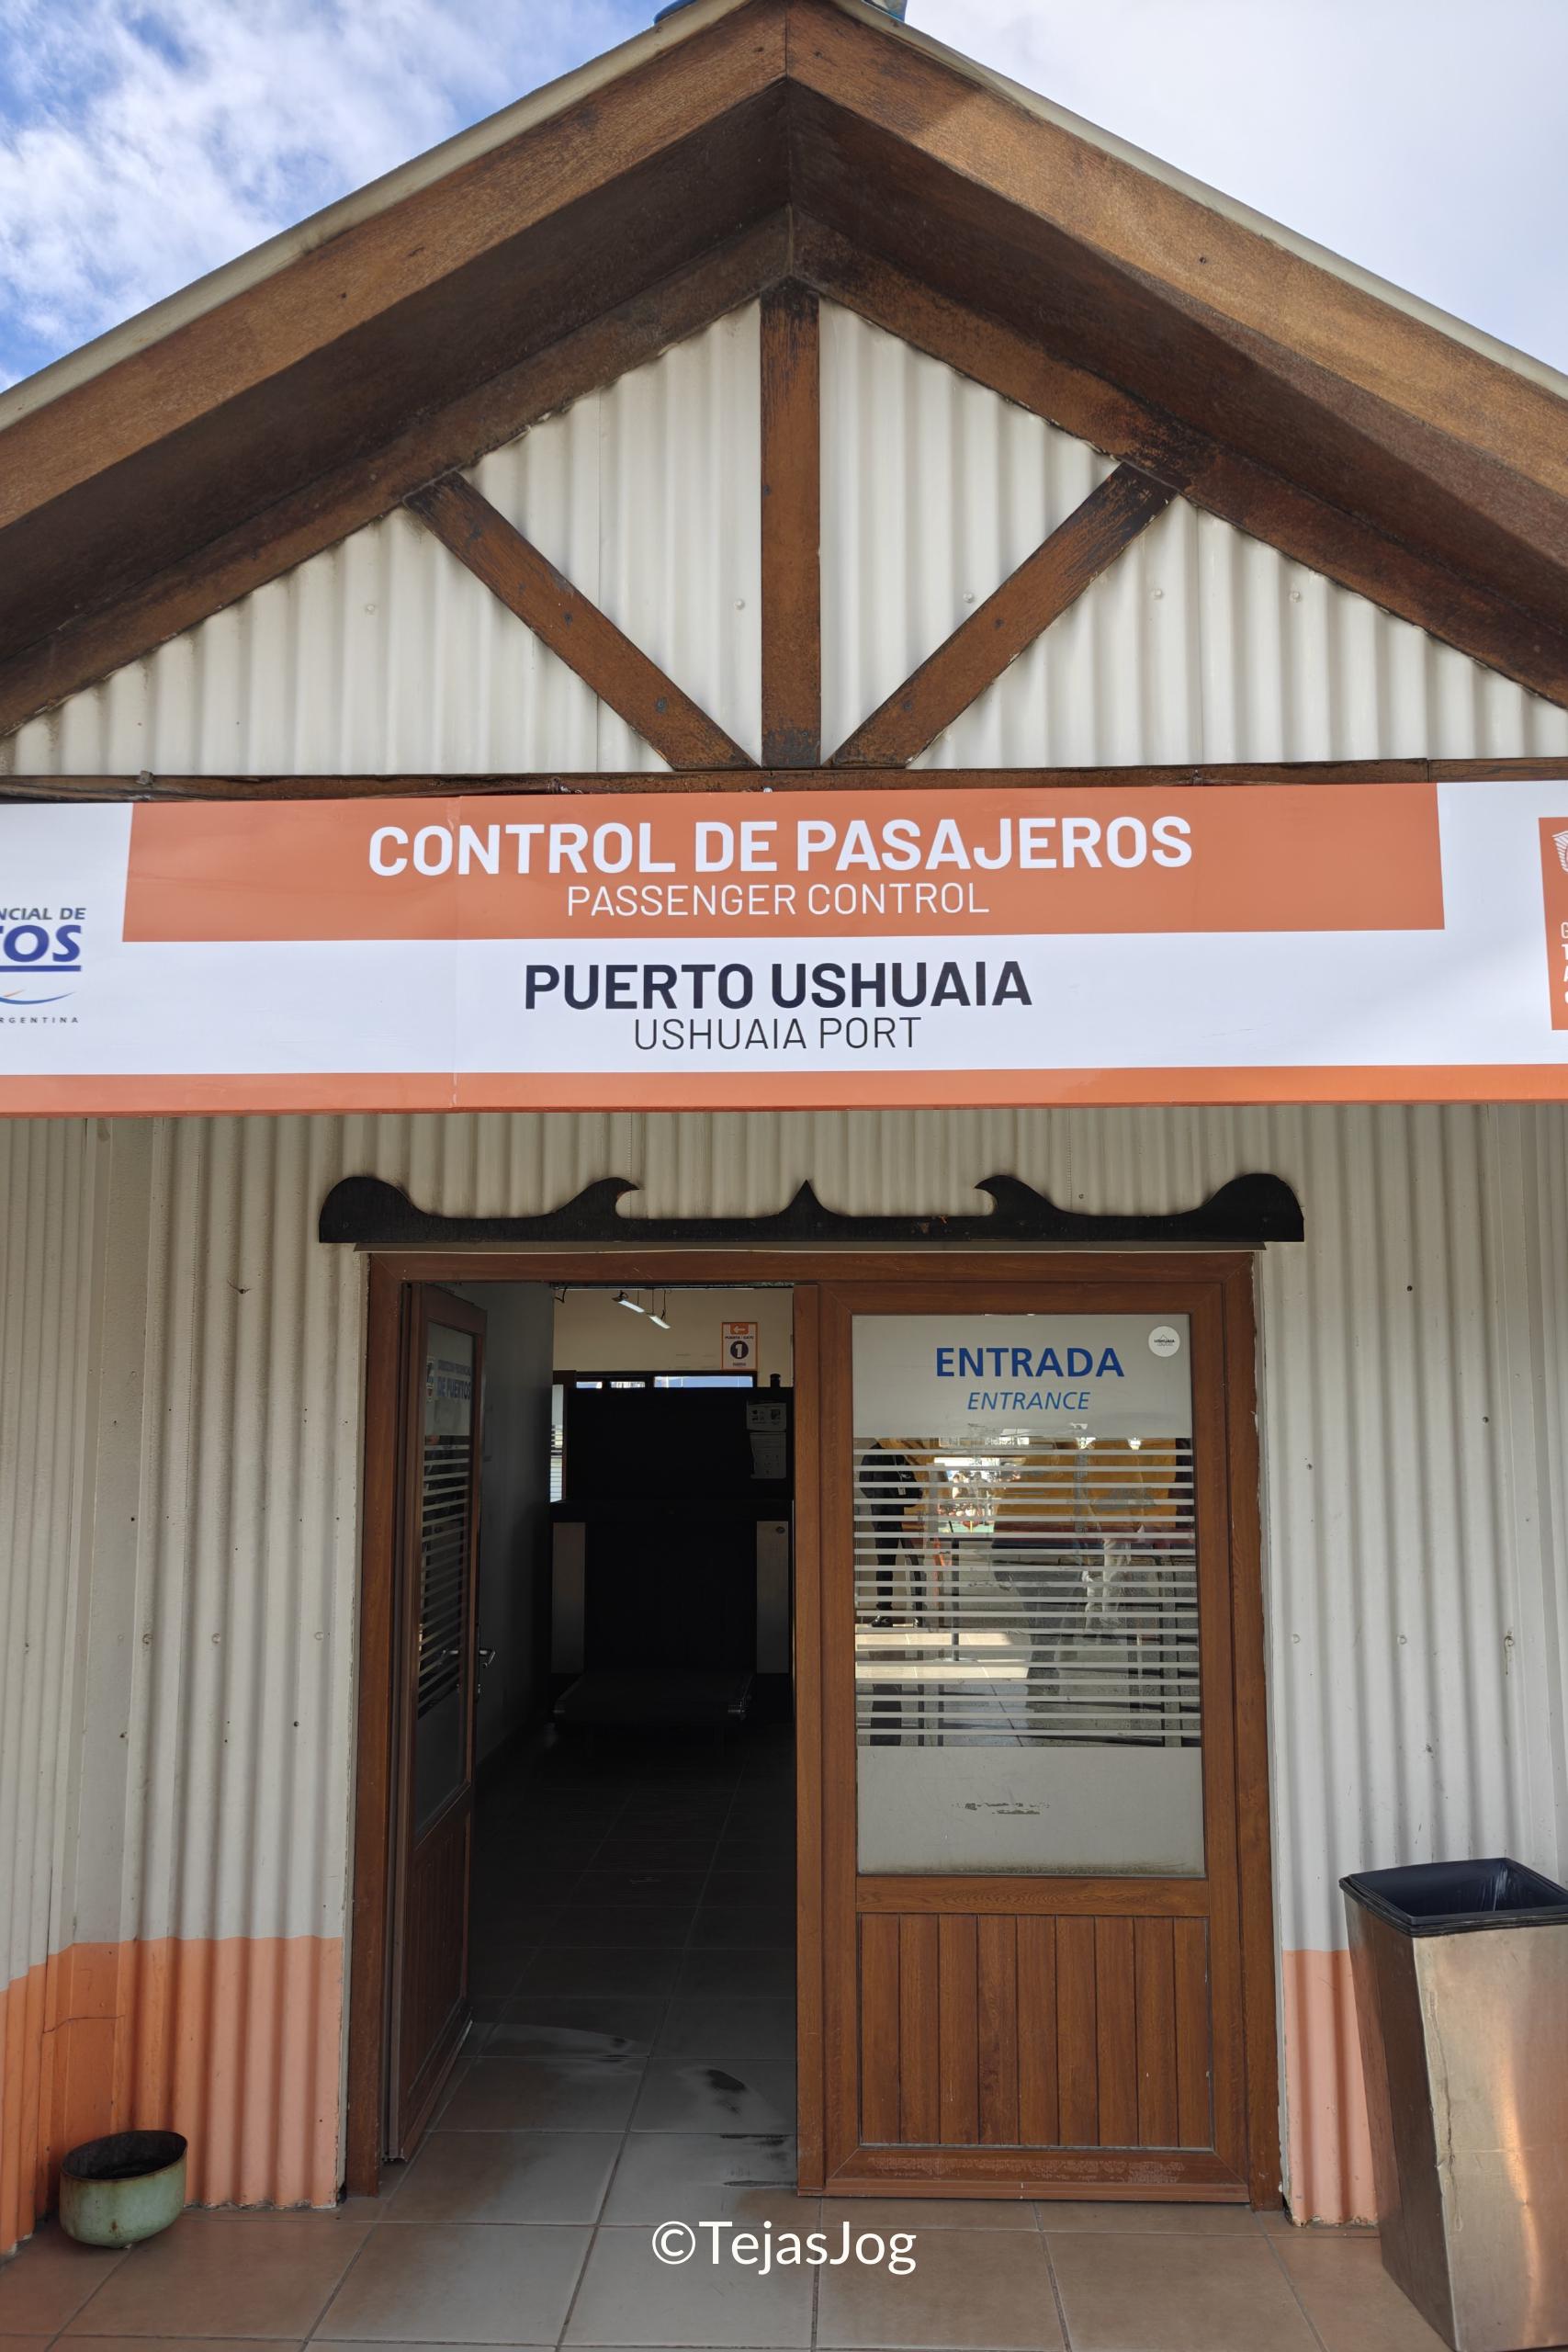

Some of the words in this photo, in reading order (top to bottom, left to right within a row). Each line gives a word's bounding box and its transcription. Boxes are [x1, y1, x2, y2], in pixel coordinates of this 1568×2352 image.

[369, 822, 676, 876] CONTROL
[695, 820, 777, 873] DE
[797, 816, 1192, 871] PASAJEROS
[60, 908, 86, 920] DE
[568, 884, 795, 916] PASSENGER
[808, 882, 989, 915] CONTROL
[0, 924, 82, 963] OS
[525, 963, 753, 1010] PUERTO
[771, 960, 1032, 1009] USHUAIA
[635, 1018, 807, 1050] USHUAIA
[819, 1016, 921, 1049] PORT
[736, 1343, 742, 1358] 1
[936, 1347, 1125, 1378] ENTRADA
[967, 1392, 1091, 1411] ENTRANCE
